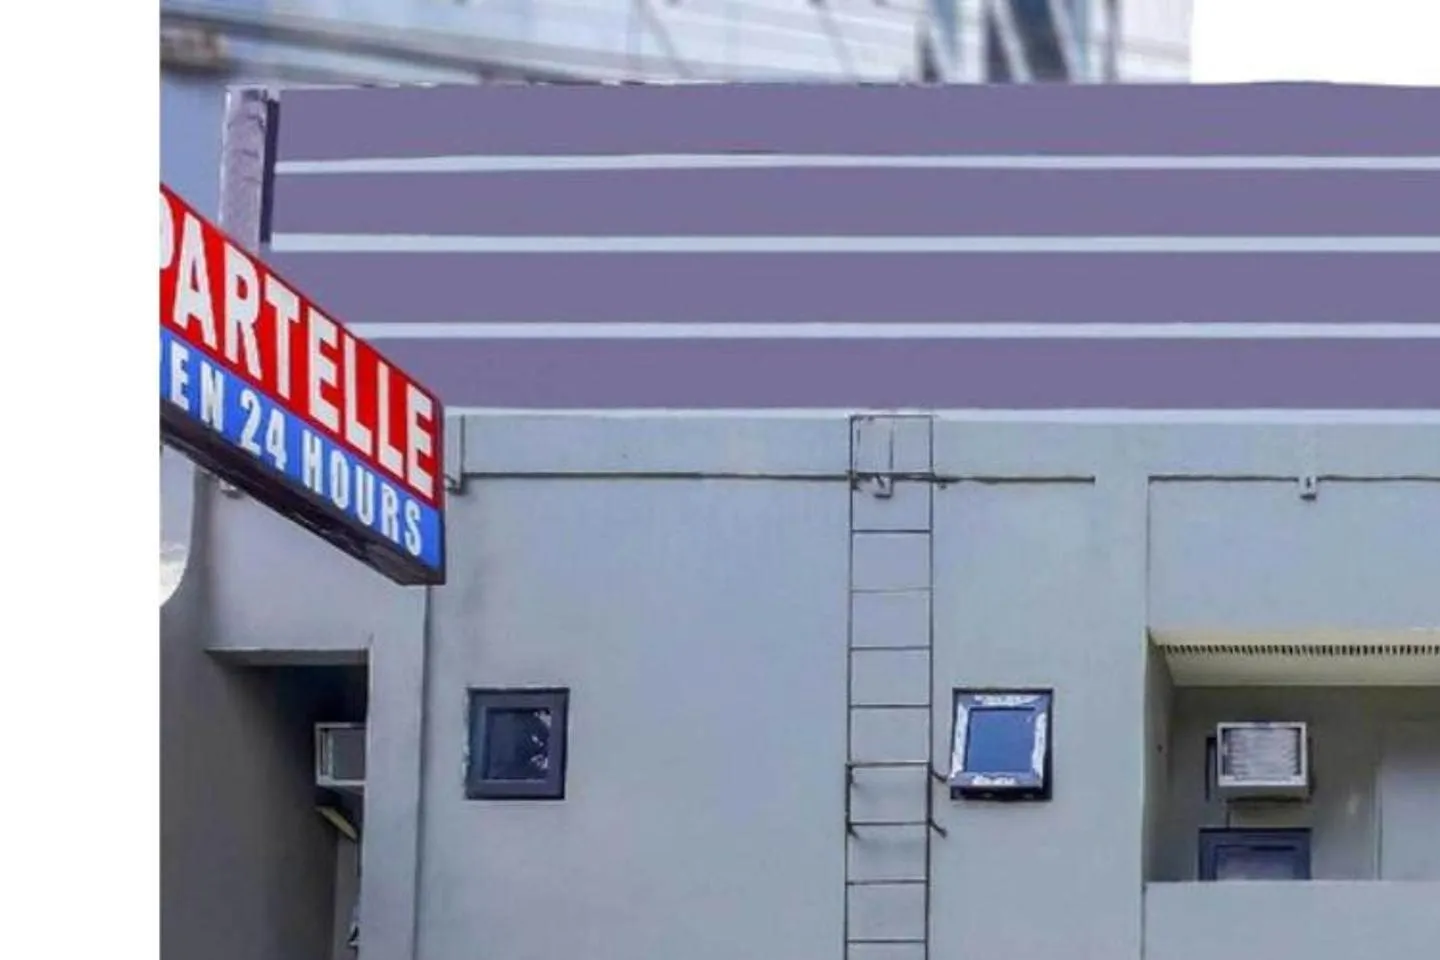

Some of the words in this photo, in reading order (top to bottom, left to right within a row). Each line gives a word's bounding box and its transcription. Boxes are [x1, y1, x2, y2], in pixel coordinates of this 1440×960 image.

[159, 337, 225, 433] EN
[239, 387, 288, 473] 24
[302, 428, 422, 557] HOURS
